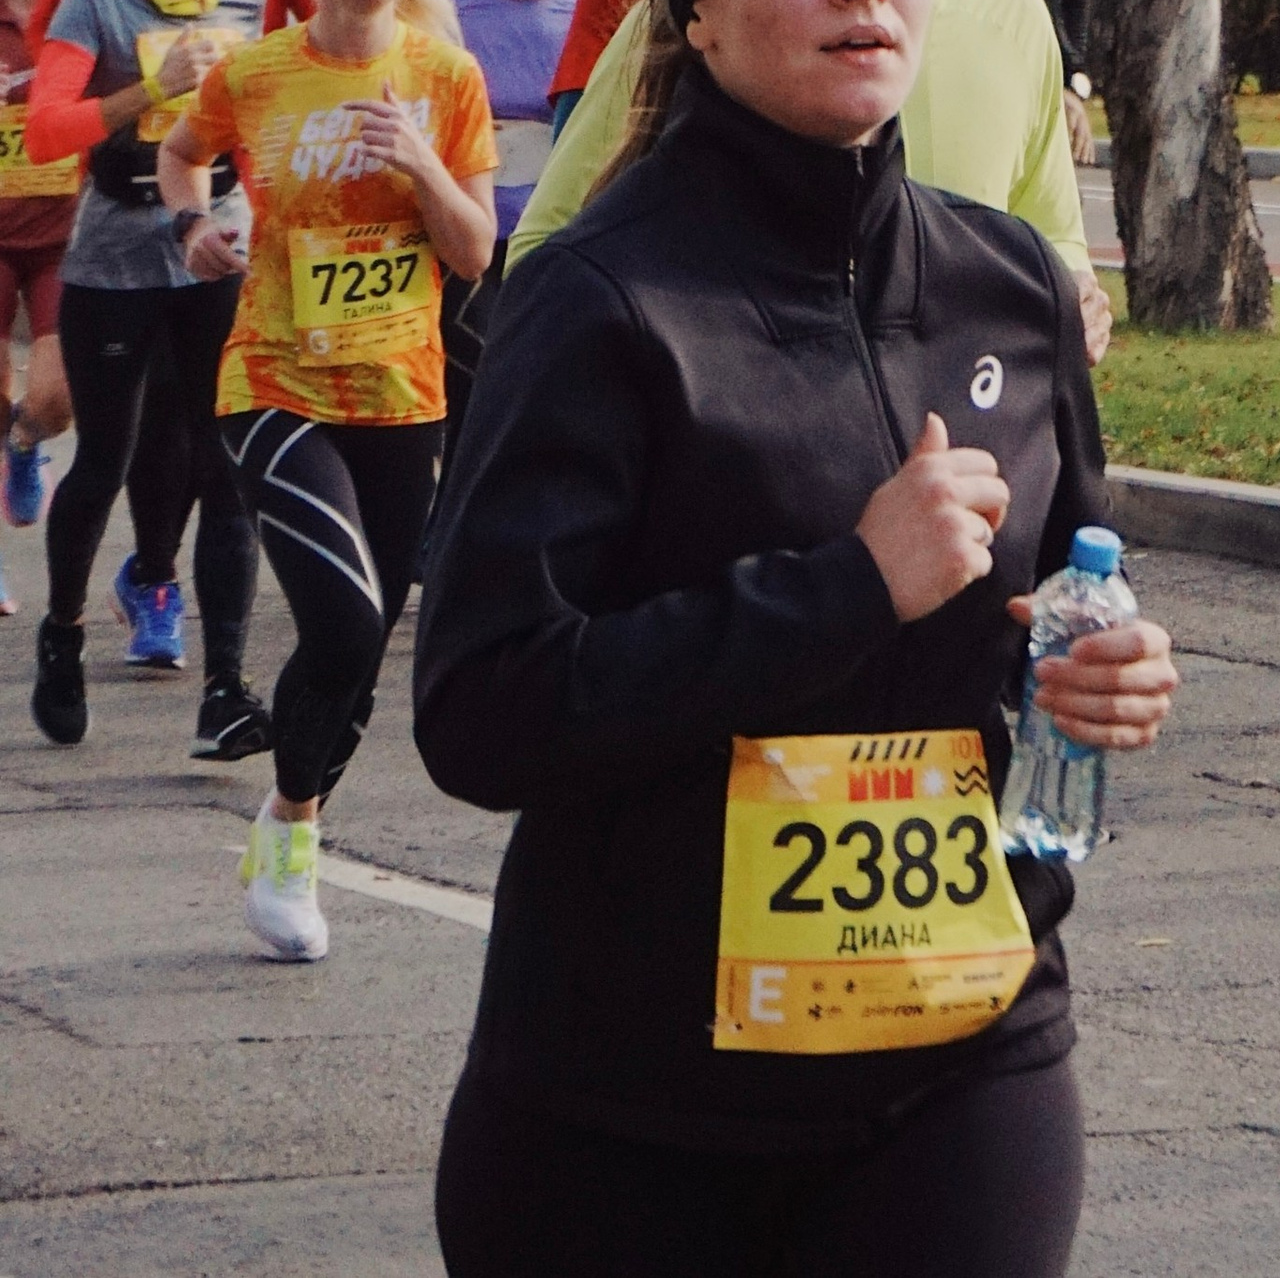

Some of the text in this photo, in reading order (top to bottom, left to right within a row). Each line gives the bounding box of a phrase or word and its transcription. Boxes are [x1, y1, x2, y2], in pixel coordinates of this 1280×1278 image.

[311, 253, 419, 305] 7237
[343, 302, 393, 319] ГАЛИНА
[769, 814, 989, 913] 2383
[836, 922, 931, 955] ДИАНА
[748, 967, 787, 1023] E
